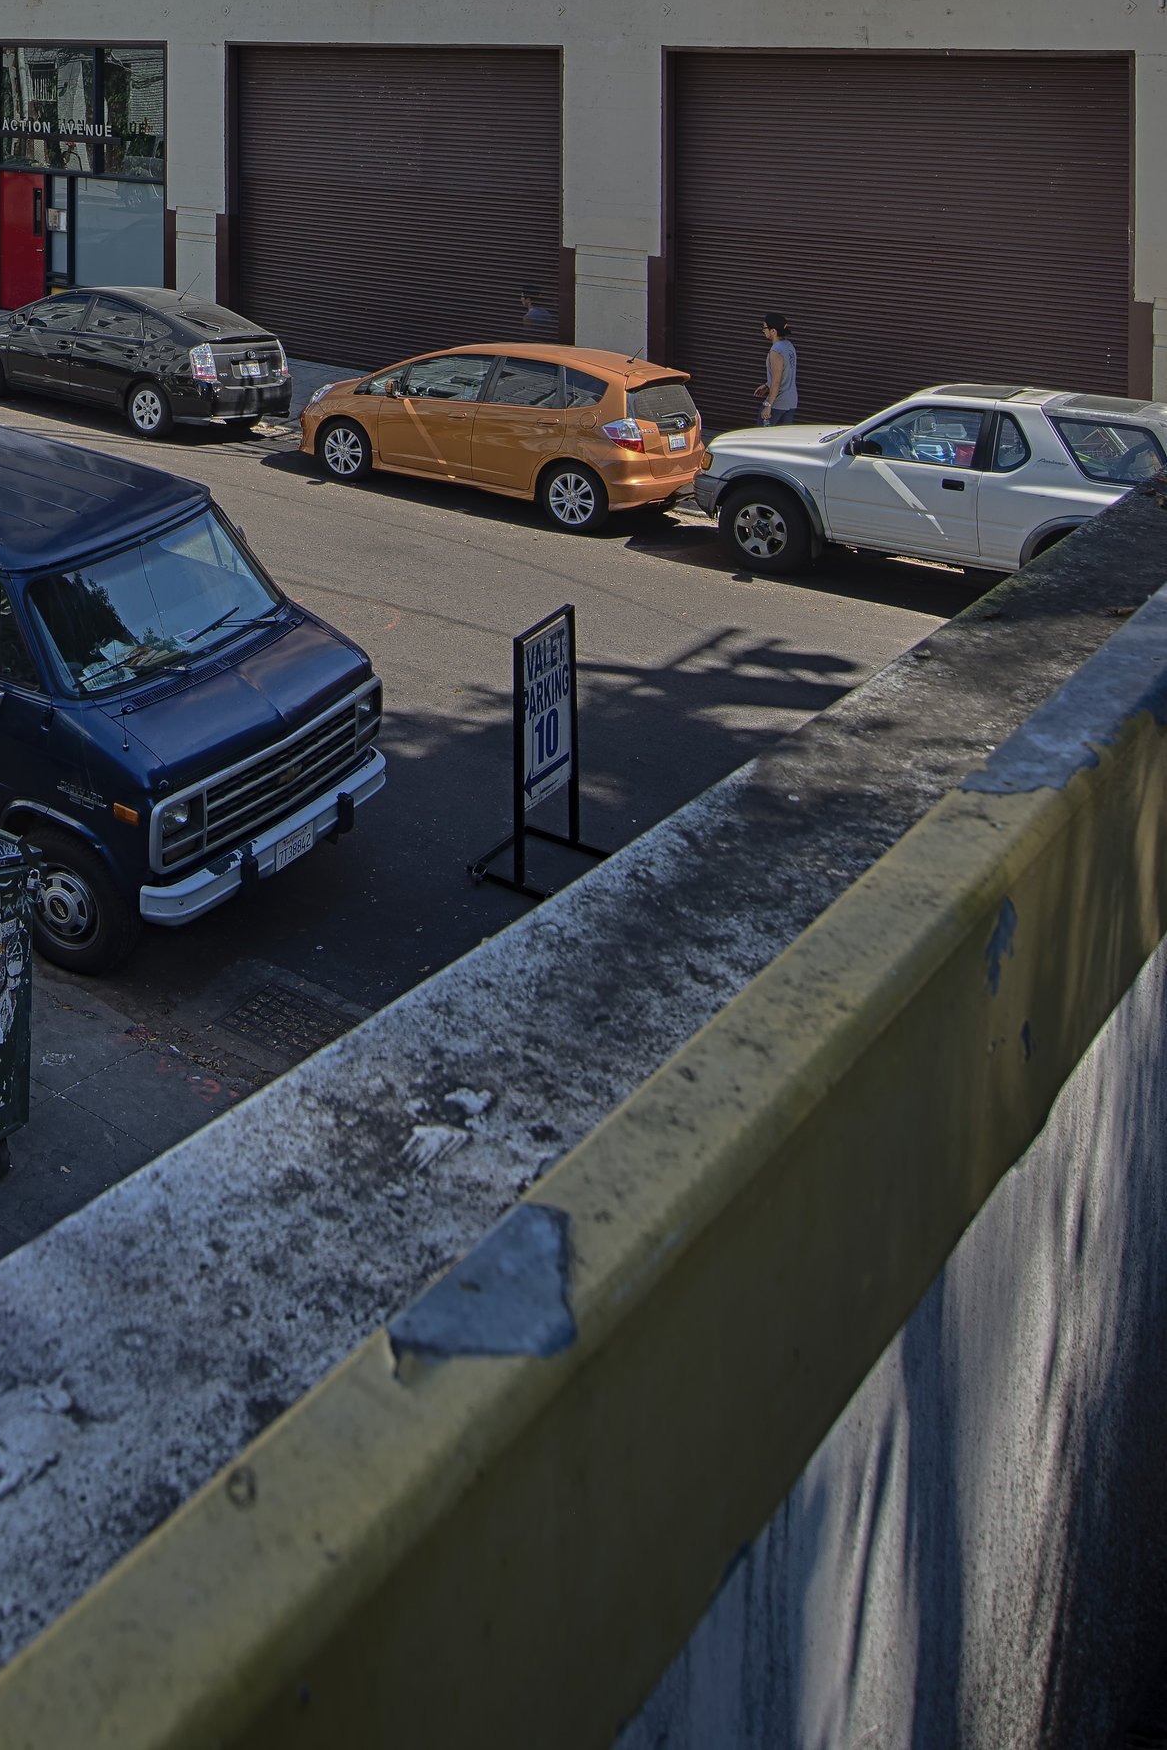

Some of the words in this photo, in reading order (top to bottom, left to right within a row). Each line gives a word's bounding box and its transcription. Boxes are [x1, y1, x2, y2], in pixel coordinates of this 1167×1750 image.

[60, 122, 113, 138] AVENUE
[525, 628, 565, 682] VALET
[524, 663, 569, 725] PARKING
[534, 711, 560, 765] 10
